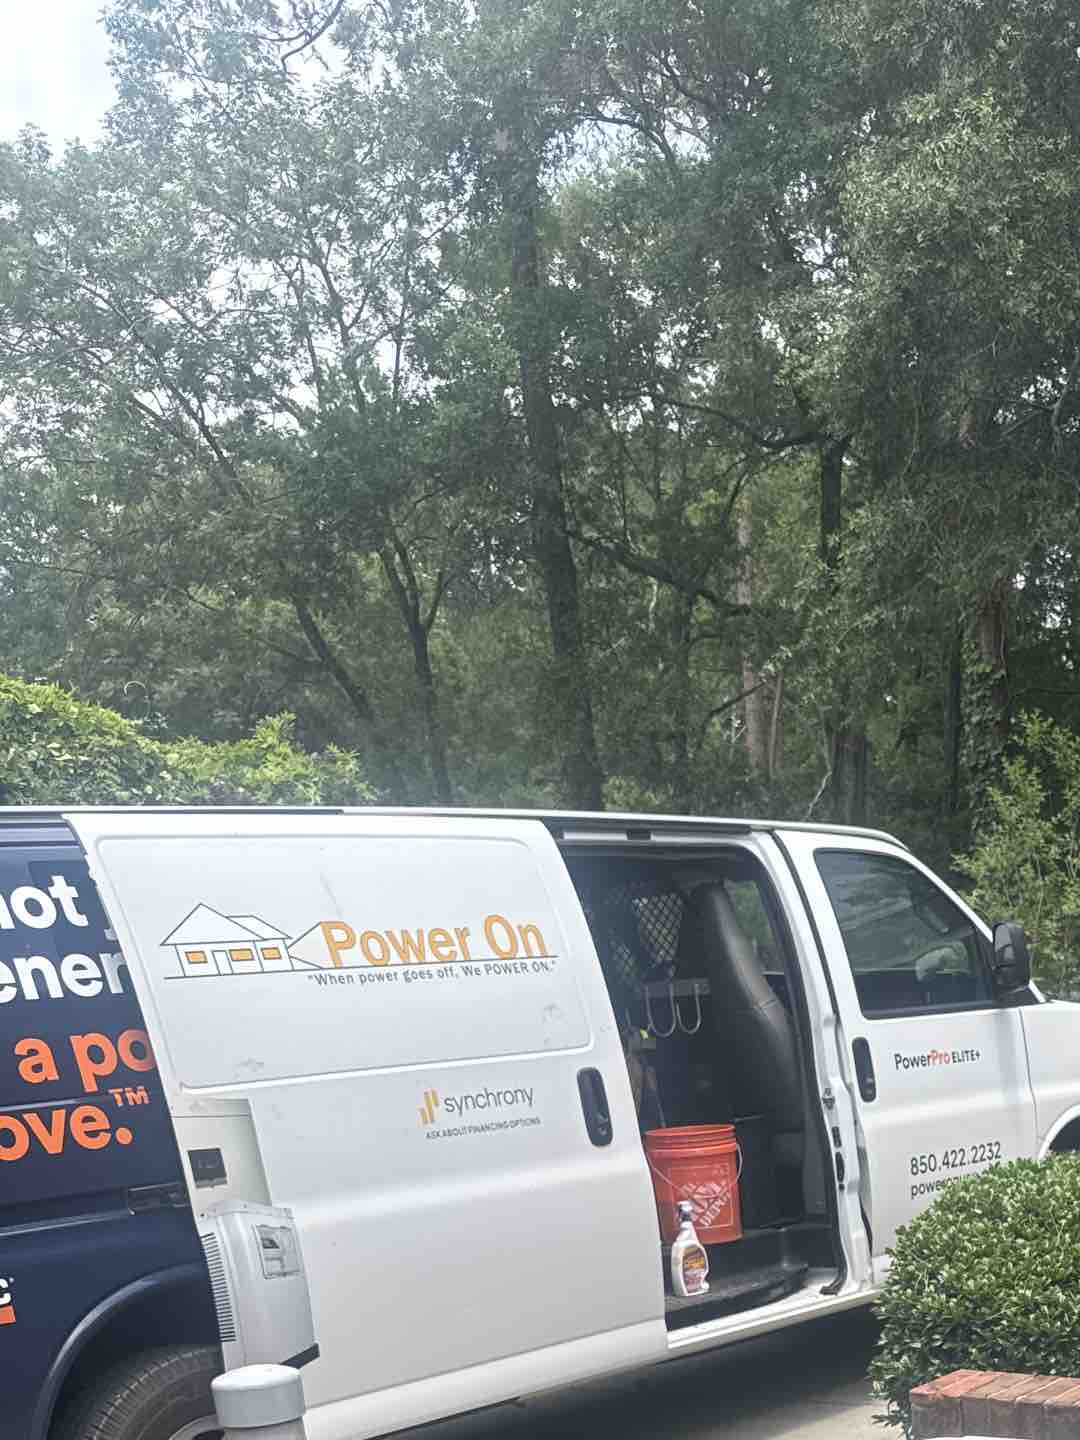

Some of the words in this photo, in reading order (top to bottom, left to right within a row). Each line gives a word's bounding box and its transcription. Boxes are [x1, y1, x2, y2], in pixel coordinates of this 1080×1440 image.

[0, 875, 88, 929] ot
[319, 920, 471, 968] Power
[484, 914, 547, 960] On
[359, 971, 398, 985] power
[403, 969, 433, 983] goes
[461, 964, 481, 977] We
[484, 962, 529, 975] POWER
[14, 1037, 59, 1084] a
[69, 1028, 155, 1093] po
[894, 1049, 950, 1070] PowerPro
[444, 1087, 533, 1117] synchrony
[910, 1140, 1001, 1176] 850.422.2232
